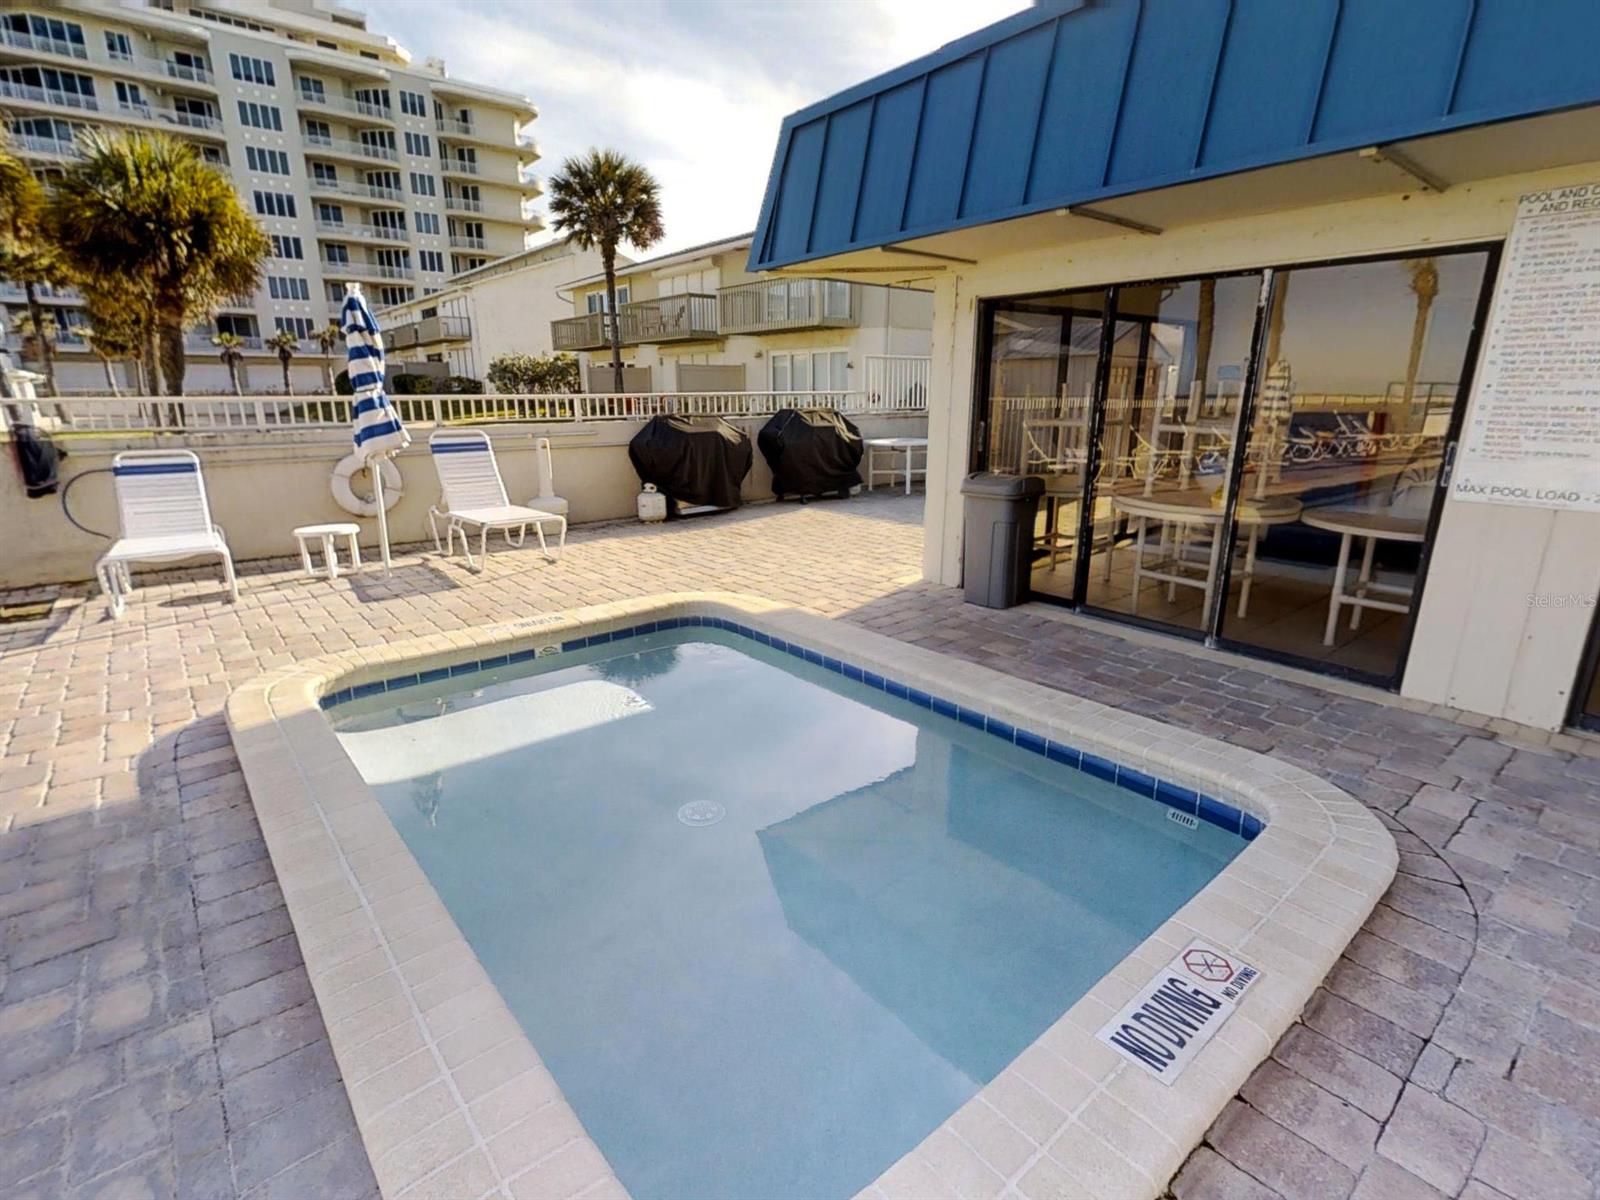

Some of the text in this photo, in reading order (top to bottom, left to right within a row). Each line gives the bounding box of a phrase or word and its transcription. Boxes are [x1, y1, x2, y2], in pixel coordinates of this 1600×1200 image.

[1518, 191, 1554, 206] POOL
[1559, 187, 1588, 199] AND
[1539, 200, 1569, 214] AND
[1455, 483, 1487, 495] MAX
[1490, 486, 1530, 499] POOL
[1535, 490, 1580, 502] LOAD
[1221, 967, 1258, 1000] NO DIVING
[1109, 977, 1223, 1073] NO DIVING
